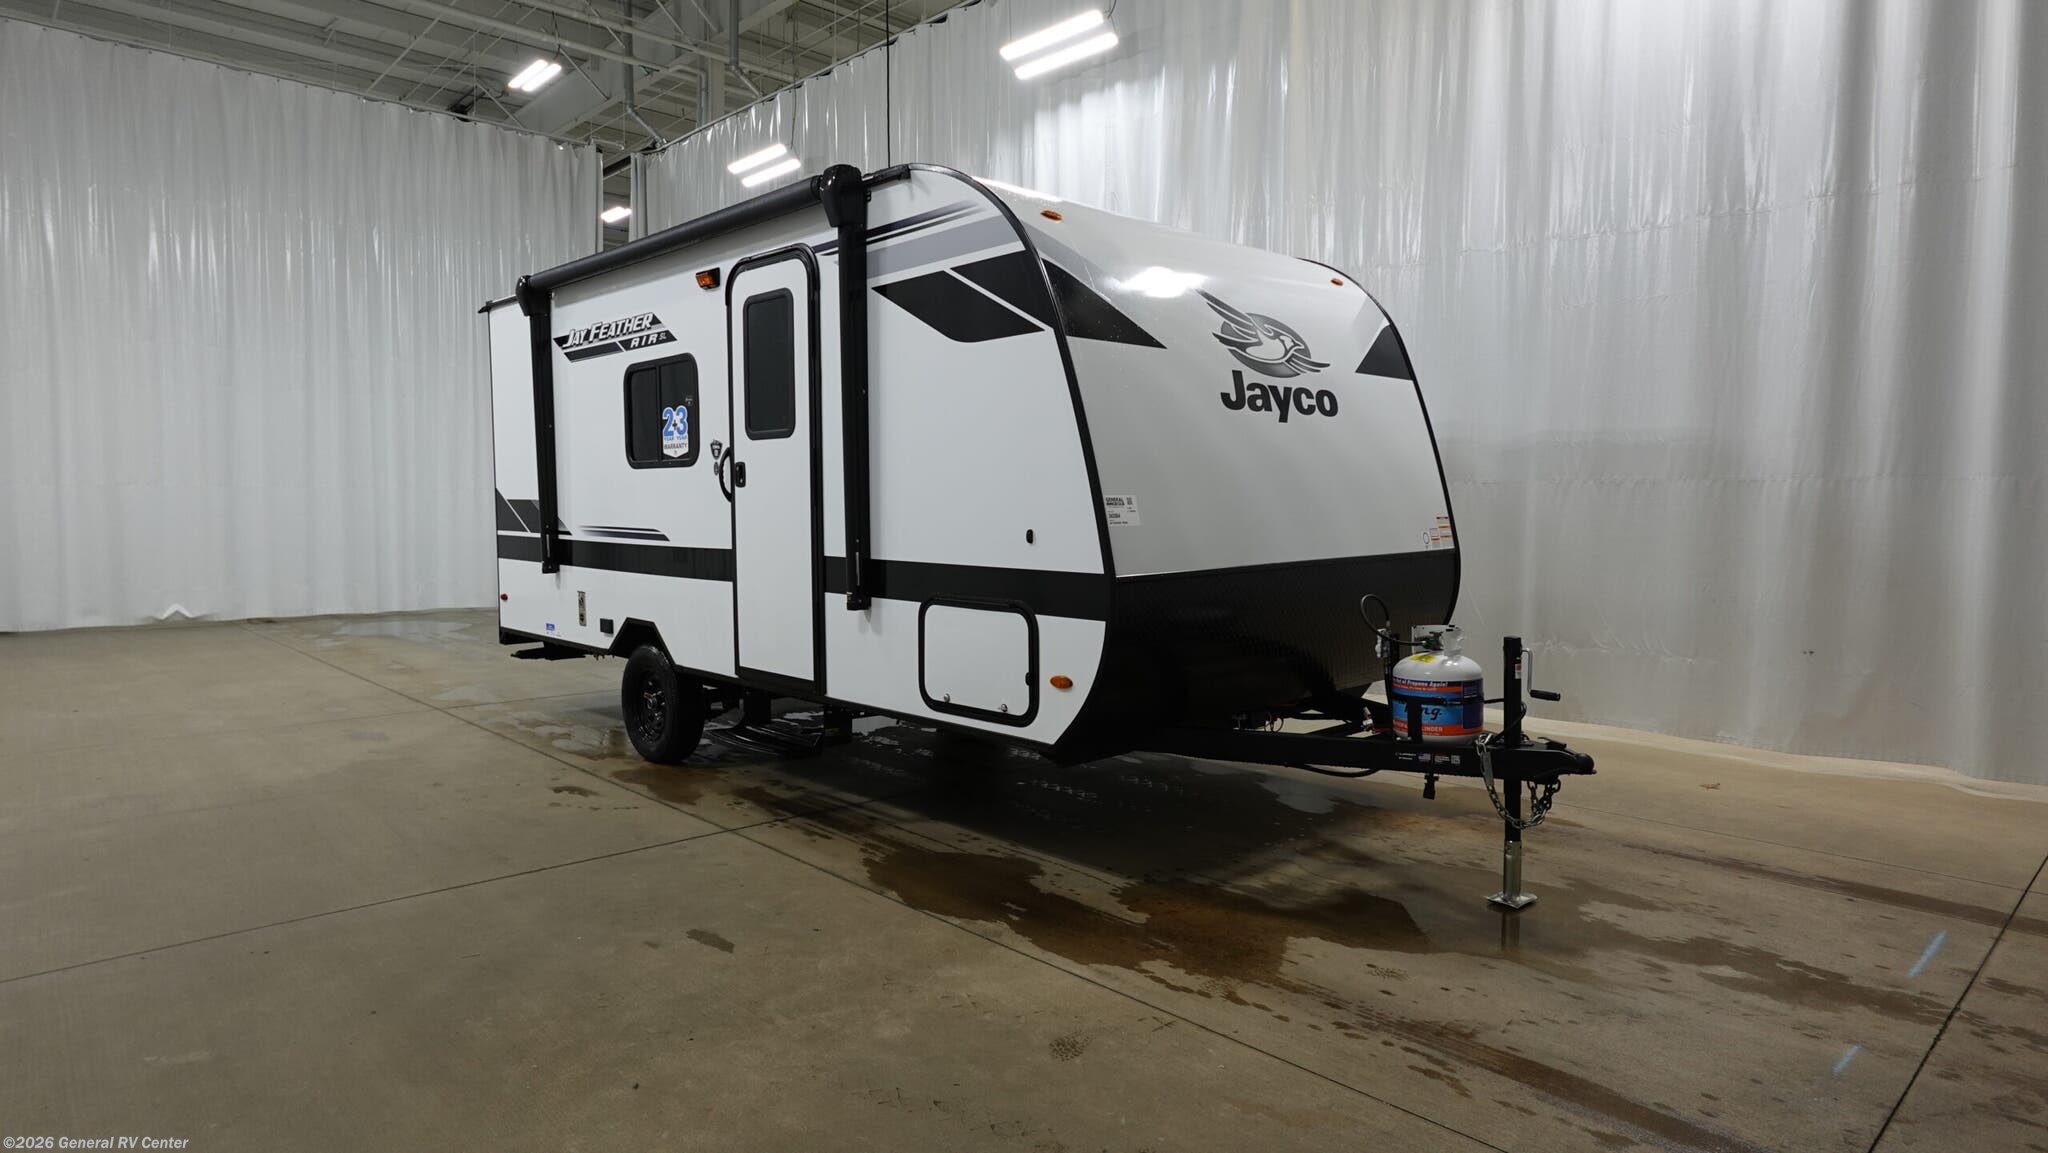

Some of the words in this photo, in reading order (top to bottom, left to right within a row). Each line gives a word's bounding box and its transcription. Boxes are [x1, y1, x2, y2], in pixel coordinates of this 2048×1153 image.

[562, 329, 588, 349] JAY
[589, 312, 653, 342] FEATHER
[630, 333, 658, 349] AIR
[1220, 370, 1338, 423] Jayco
